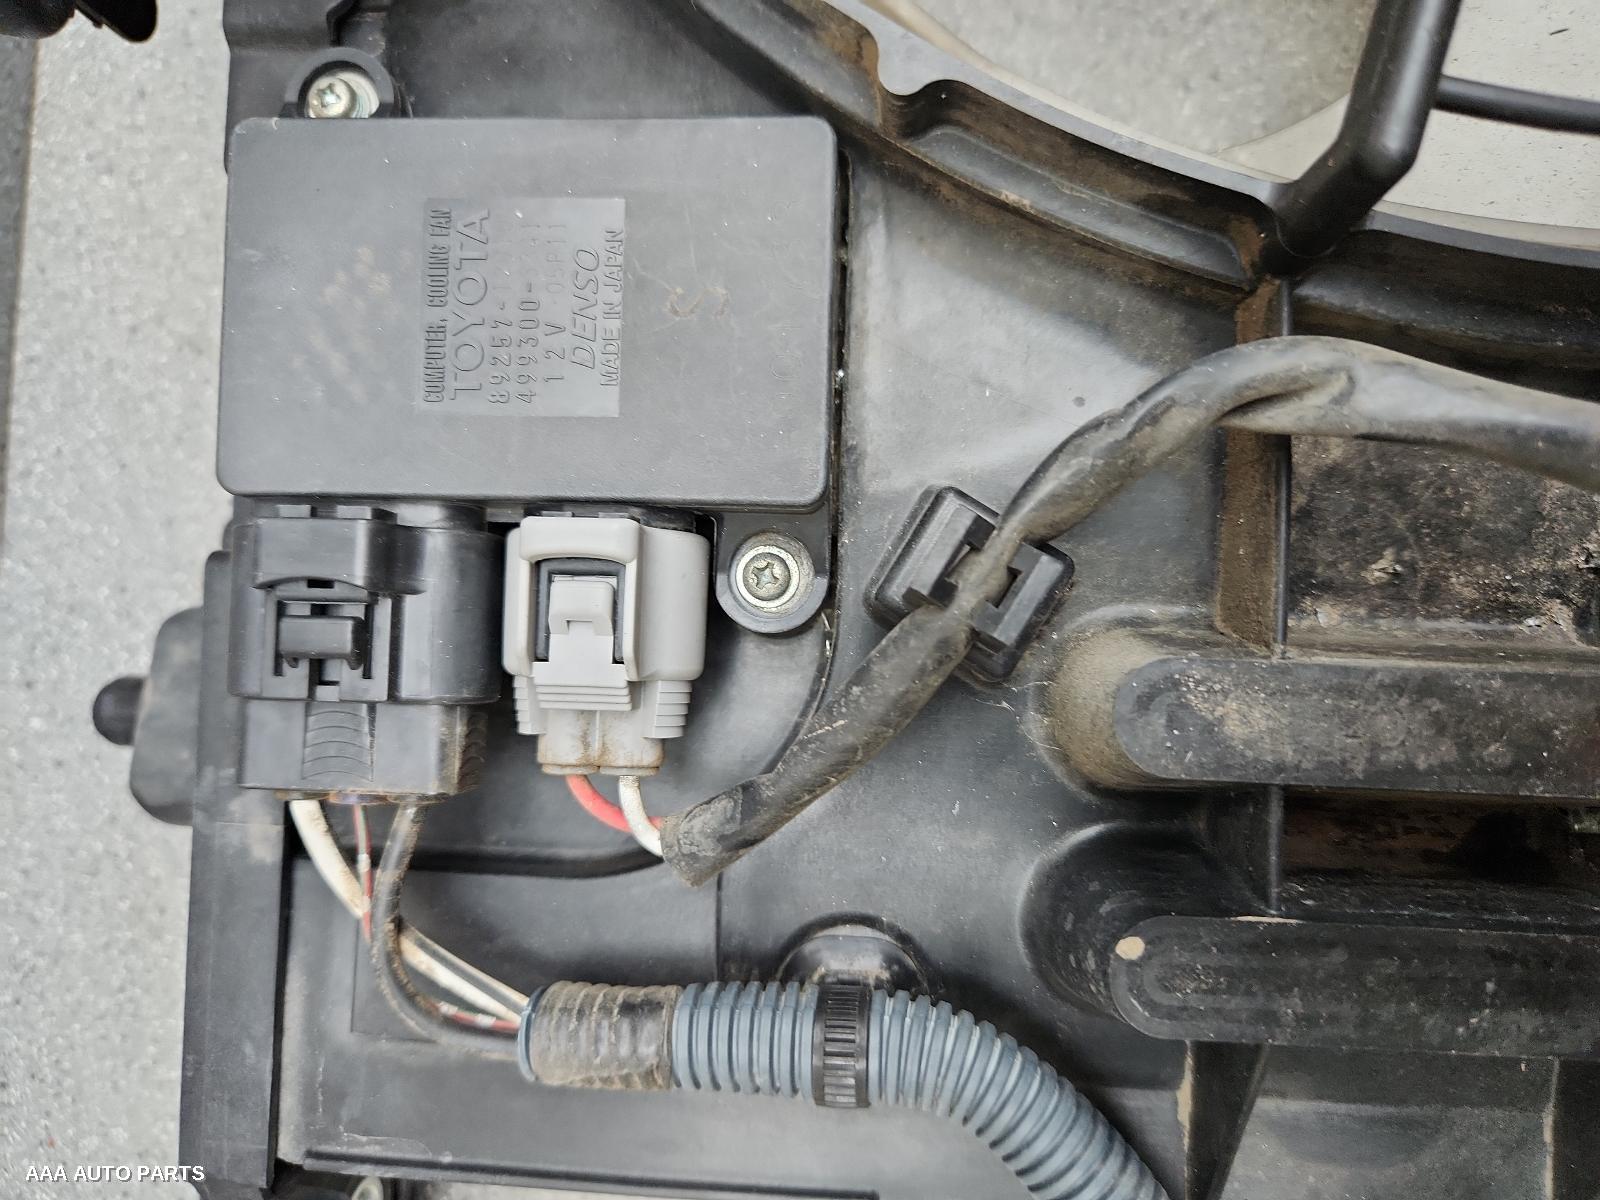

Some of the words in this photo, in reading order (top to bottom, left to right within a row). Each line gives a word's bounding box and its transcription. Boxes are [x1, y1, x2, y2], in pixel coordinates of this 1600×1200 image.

[429, 209, 451, 237] FAN
[426, 244, 450, 307] COOLING
[603, 230, 624, 293] JAPAN
[450, 208, 489, 400] TOYOTA
[571, 248, 599, 370] DENSO
[602, 302, 622, 320] IN
[423, 318, 448, 403] COMPUTER,
[600, 327, 621, 387] MADE
